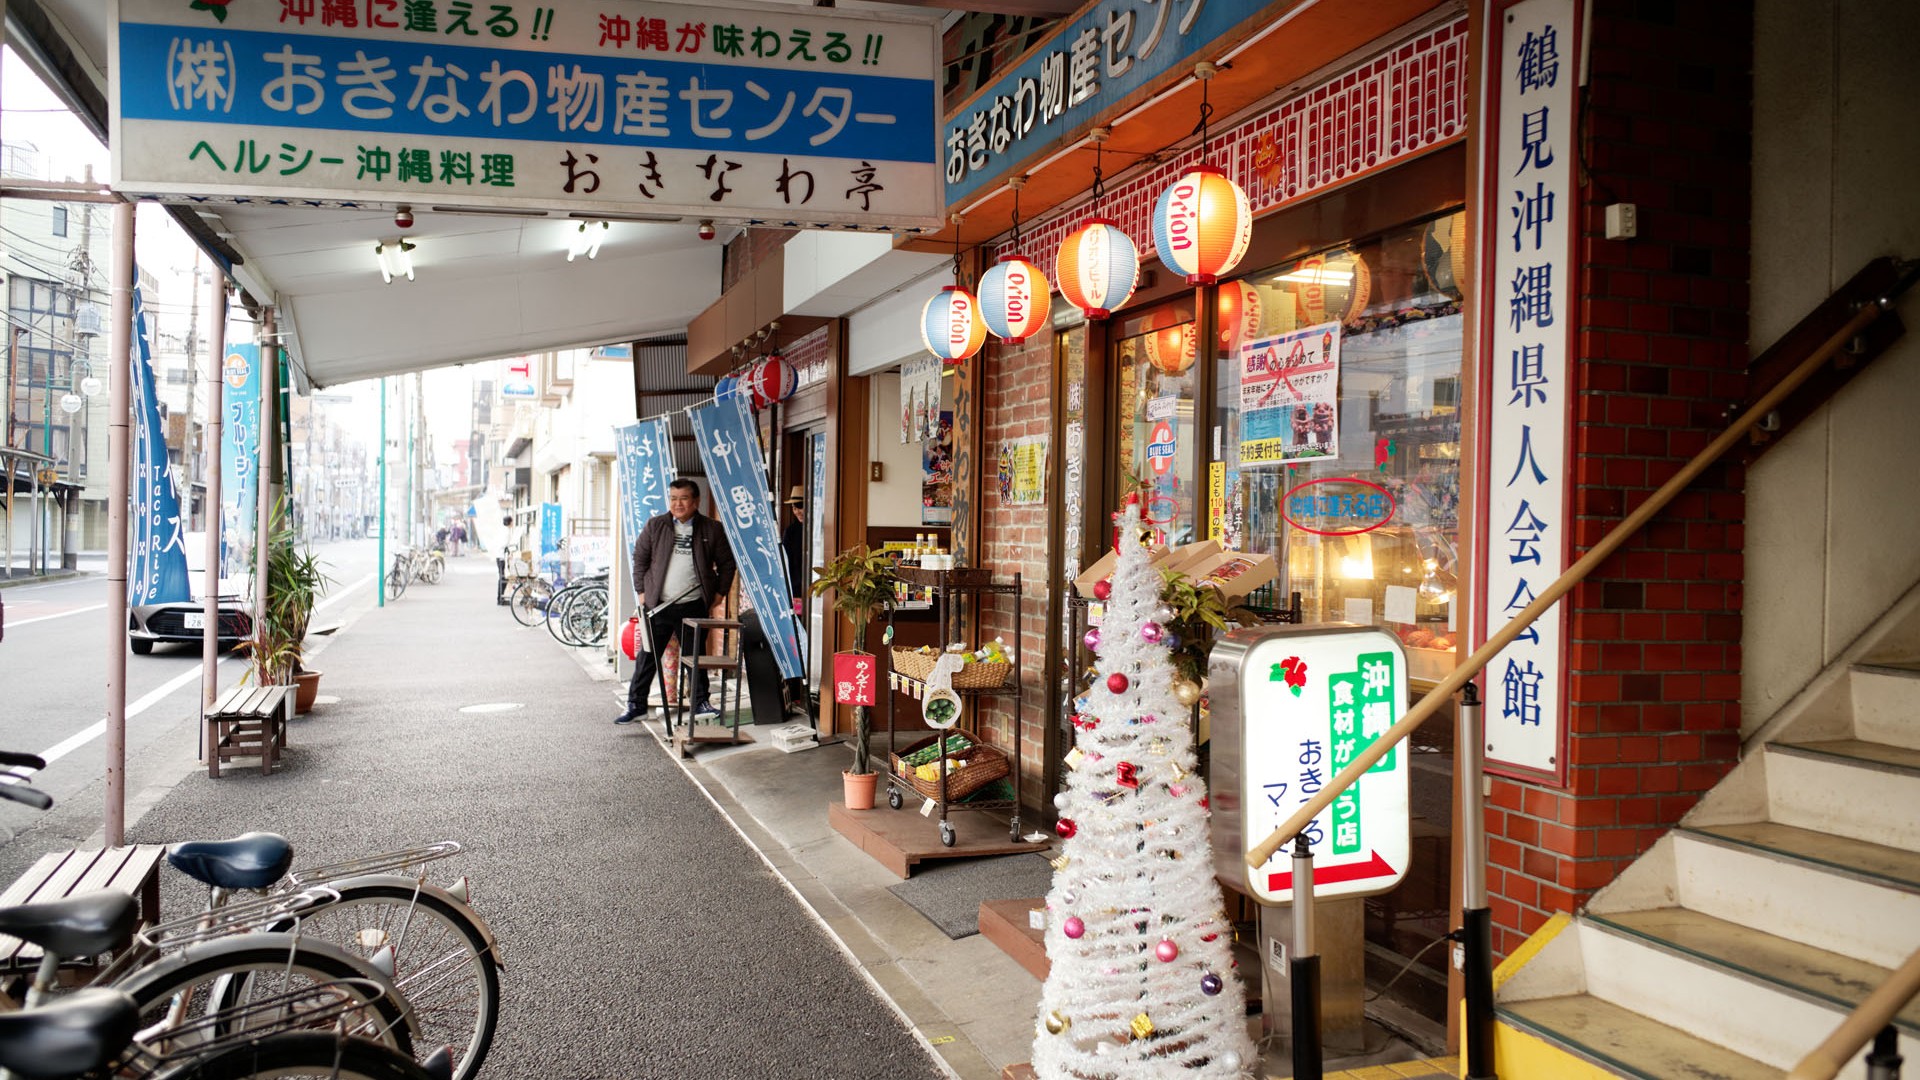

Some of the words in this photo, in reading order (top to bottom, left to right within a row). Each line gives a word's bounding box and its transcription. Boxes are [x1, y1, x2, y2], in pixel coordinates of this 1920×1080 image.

[598, 12, 884, 67] 沖縄が味わえる!!
[188, 139, 516, 188] ヘルシー沖縄料理
[559, 149, 885, 213] おきなわ亭
[1170, 185, 1196, 251] Orion
[951, 299, 970, 345] Orion
[1007, 272, 1029, 324] Orion
[1298, 738, 1324, 846] おきる
[1332, 679, 1357, 848] 食材がう店
